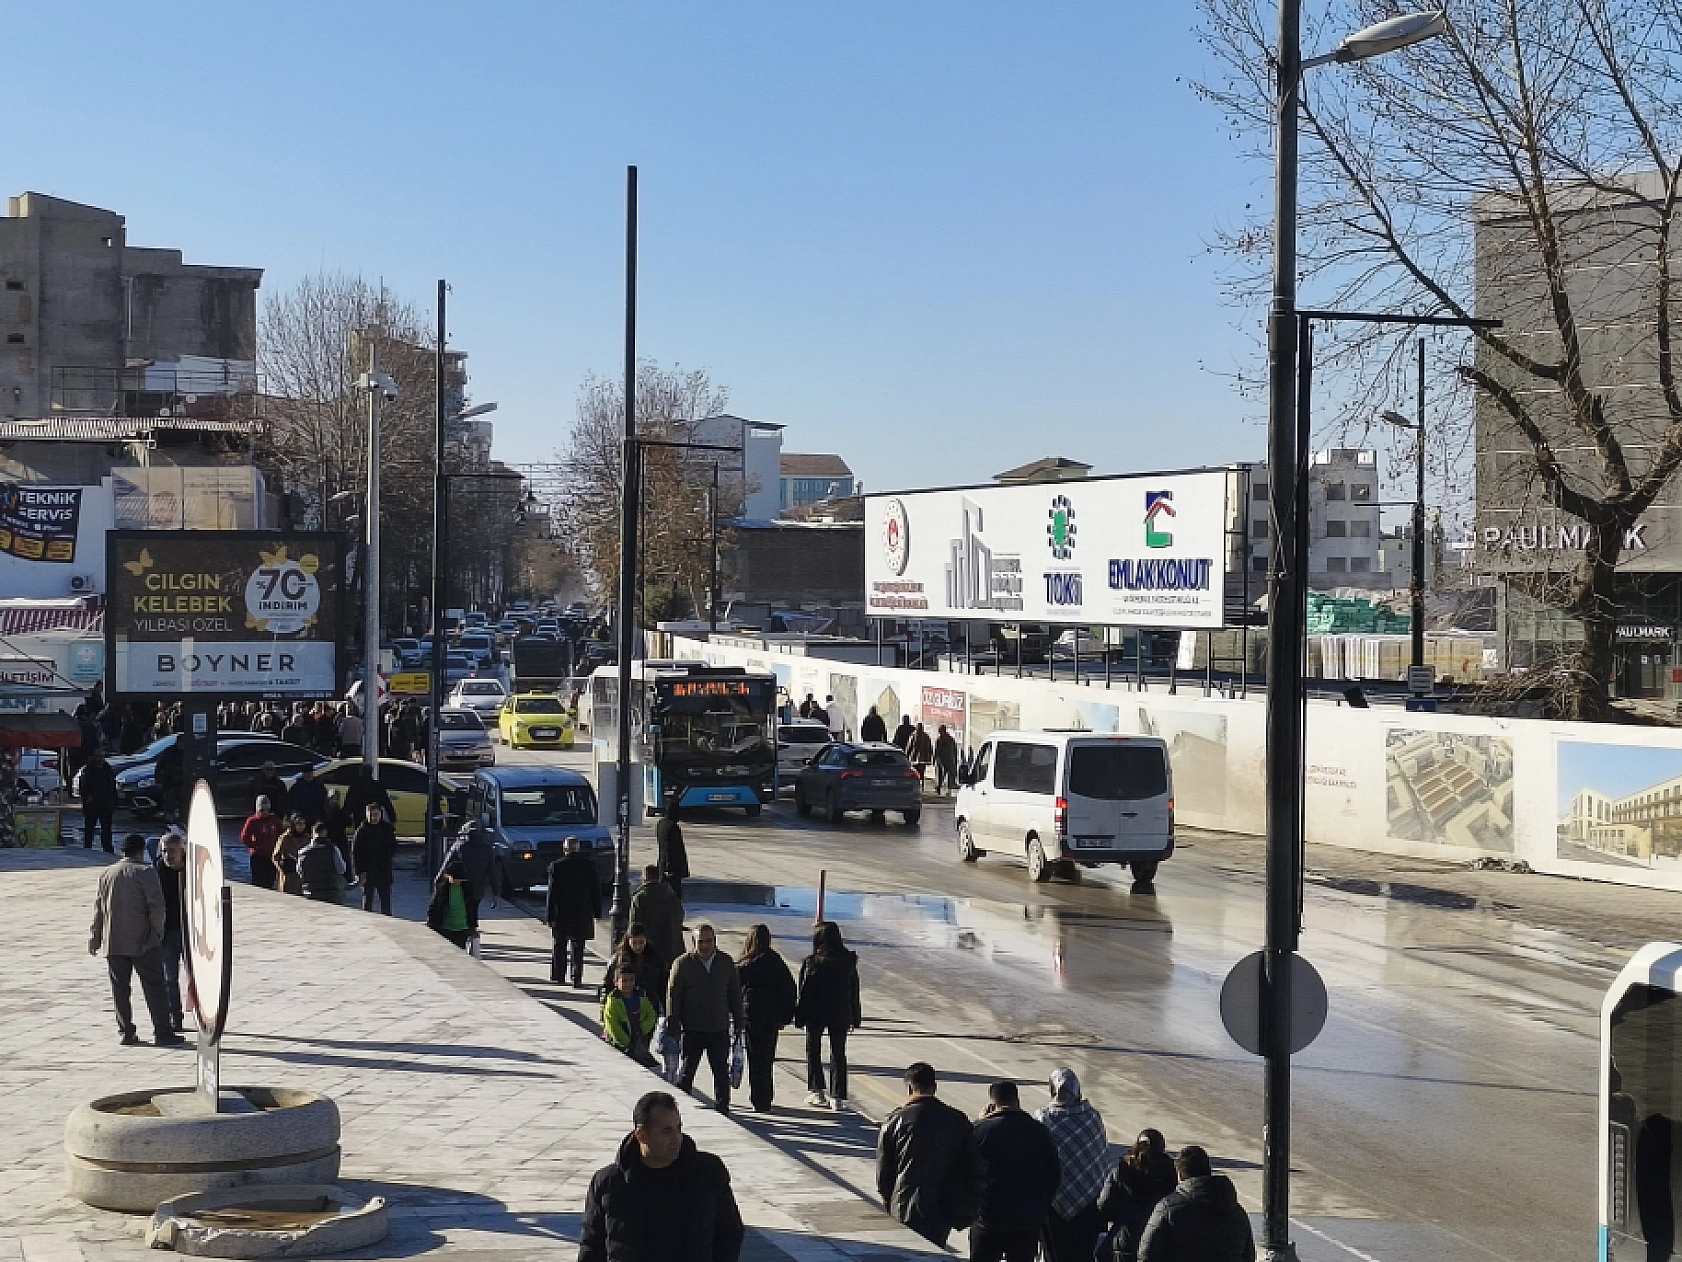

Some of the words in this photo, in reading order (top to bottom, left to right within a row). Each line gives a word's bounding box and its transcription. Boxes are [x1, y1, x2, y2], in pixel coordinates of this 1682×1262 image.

[1484, 525, 1649, 551] PAULMK
[133, 595, 233, 613] KELEBEK
[157, 654, 296, 672] BOYNER
